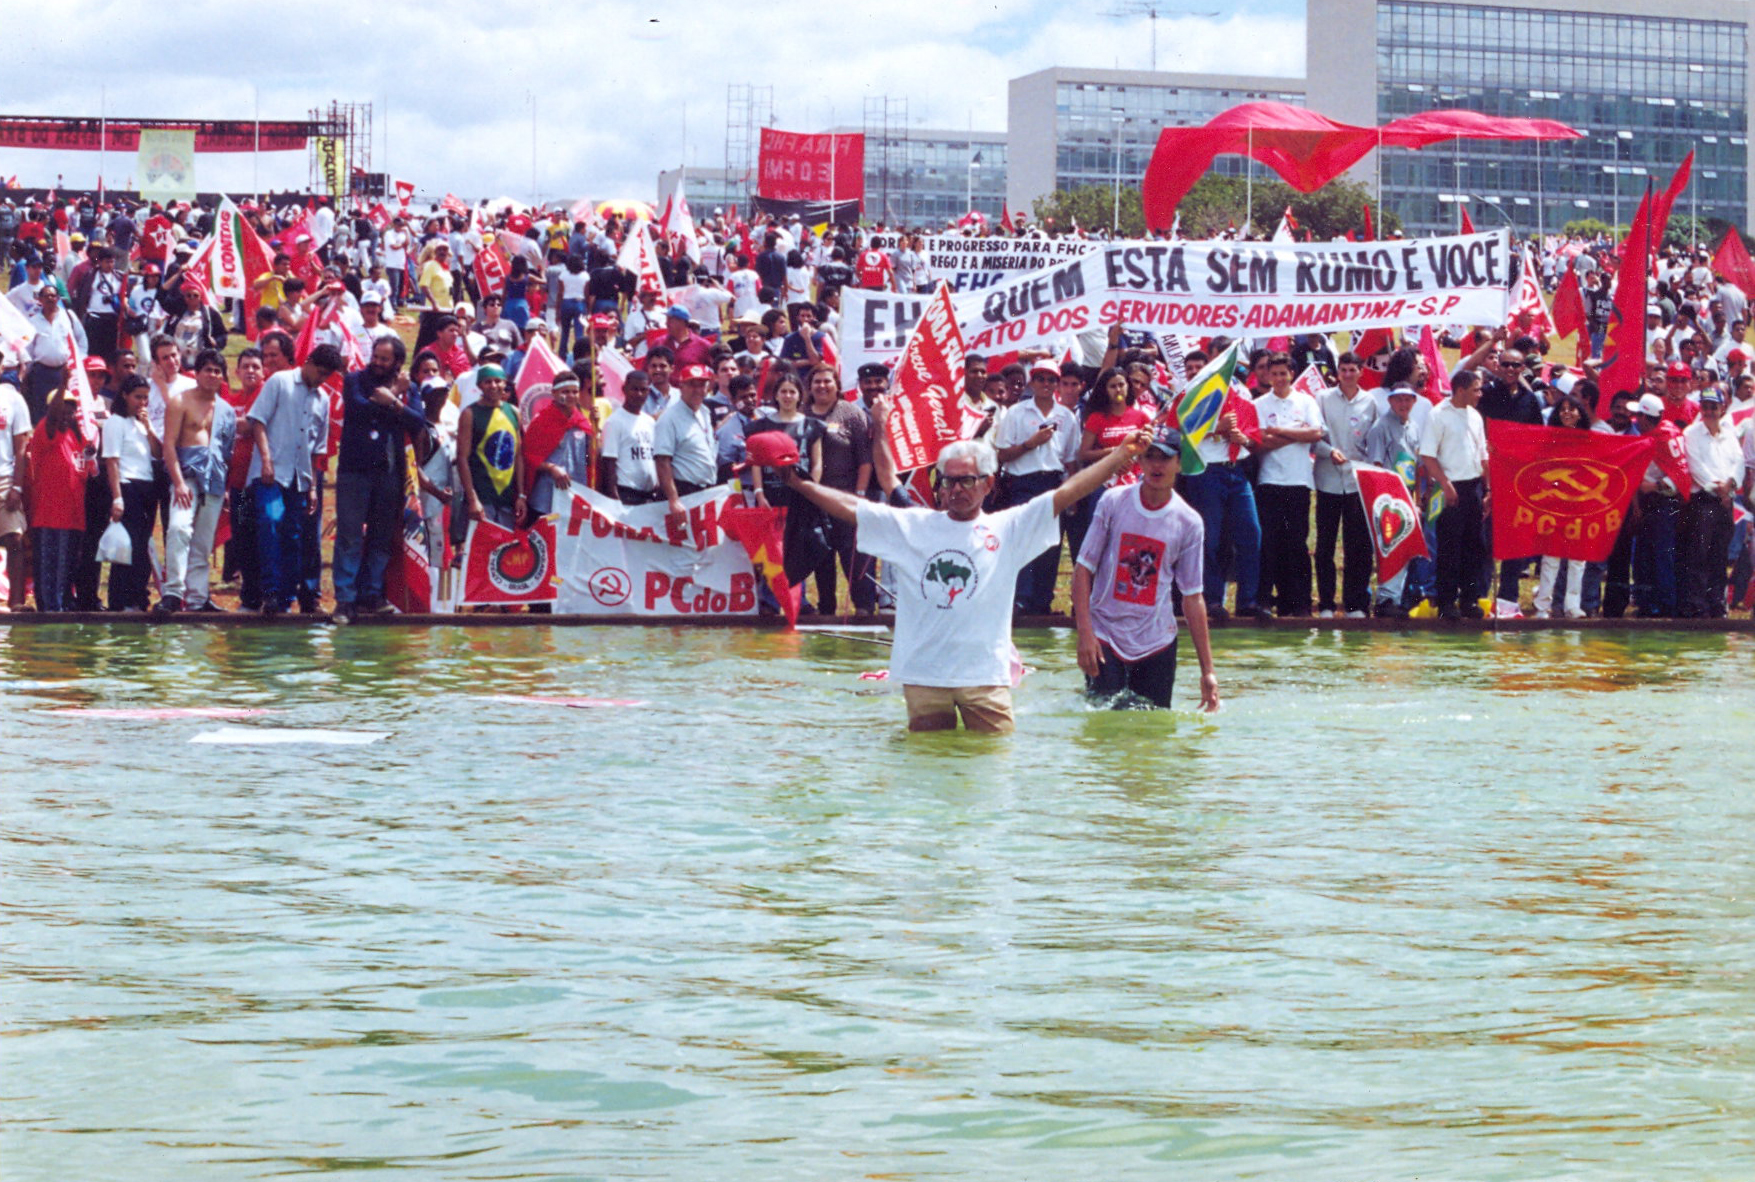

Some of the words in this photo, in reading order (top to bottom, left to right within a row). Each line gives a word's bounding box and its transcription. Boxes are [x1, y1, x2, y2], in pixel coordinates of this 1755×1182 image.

[930, 255, 958, 268] REGO
[969, 256, 978, 269] A
[1030, 256, 1045, 269] DO
[938, 238, 1008, 252] PROGRESSO
[1013, 241, 1050, 253] PARA
[1056, 243, 1086, 256] FHC
[982, 261, 1086, 323] QUEM
[1206, 250, 1278, 293] SEM
[1295, 249, 1398, 294] RUMO
[1401, 240, 1423, 290] É
[1037, 305, 1090, 336] DOS
[1512, 505, 1621, 541] PCdoB
[645, 571, 755, 613] PCdoB
